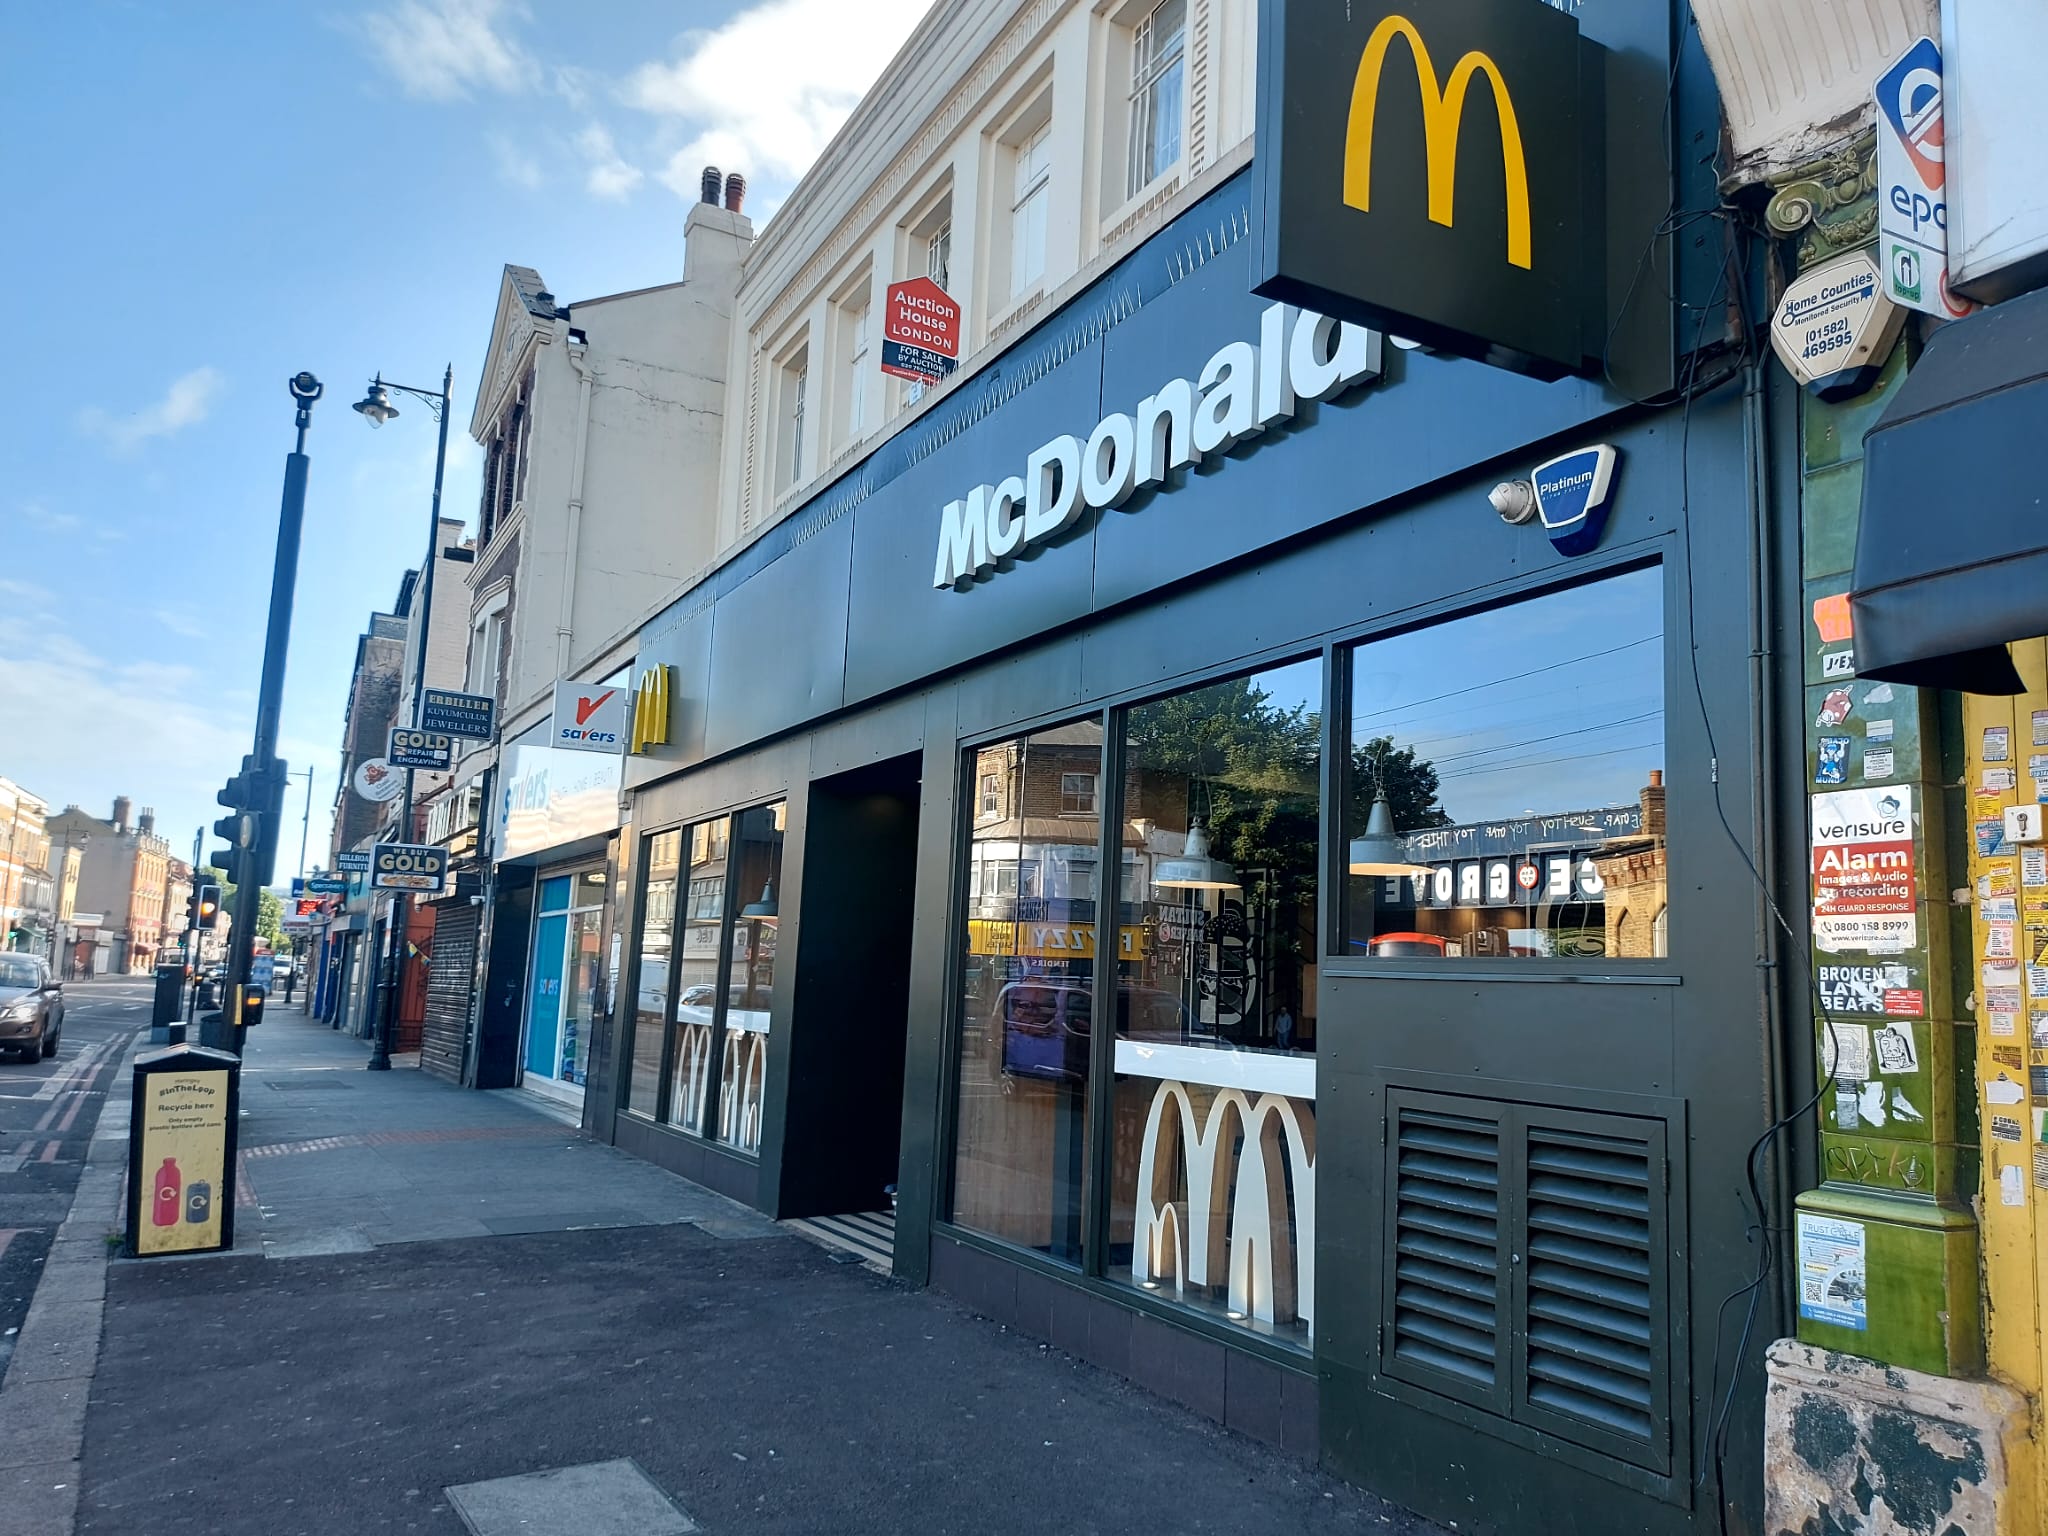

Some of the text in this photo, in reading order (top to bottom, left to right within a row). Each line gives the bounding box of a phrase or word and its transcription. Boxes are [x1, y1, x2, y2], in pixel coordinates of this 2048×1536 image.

[1785, 272, 1873, 313] Home Counties
[1895, 284, 1920, 299] top-up
[895, 290, 954, 319] Auction
[1795, 296, 1860, 326] Monitored Security
[900, 307, 947, 331] House
[893, 323, 952, 350] LONDON
[1806, 317, 1848, 345] (01582)
[1802, 331, 1852, 360] 469595
[898, 354, 945, 372] BY AUCTION
[900, 345, 943, 365] FOR SALE
[1540, 471, 1592, 496] Platinum
[429, 694, 489, 711] ERBILLER
[427, 707, 488, 722] KUYUMCULUK
[425, 718, 488, 734] JEWELLERS
[394, 731, 449, 750] GOLD
[561, 728, 616, 743] savers
[407, 748, 434, 757] REPAIR
[397, 756, 442, 766] ENGRAVING
[1819, 820, 1905, 839] verisure
[393, 847, 430, 856] WE BUY
[380, 853, 440, 873] GOLD
[1819, 848, 1908, 872] Alarm
[1820, 871, 1908, 886] Images & Audio
[1842, 883, 1909, 899] recording
[1821, 902, 1909, 913] 24H GUARD RESPONSE
[1834, 921, 1909, 931] 0800 158 8999
[1820, 966, 1883, 982] BROKEN
[1820, 996, 1884, 1012] BEATS
[159, 1084, 216, 1097] #InTheLoop
[158, 1103, 193, 1112] Recycle
